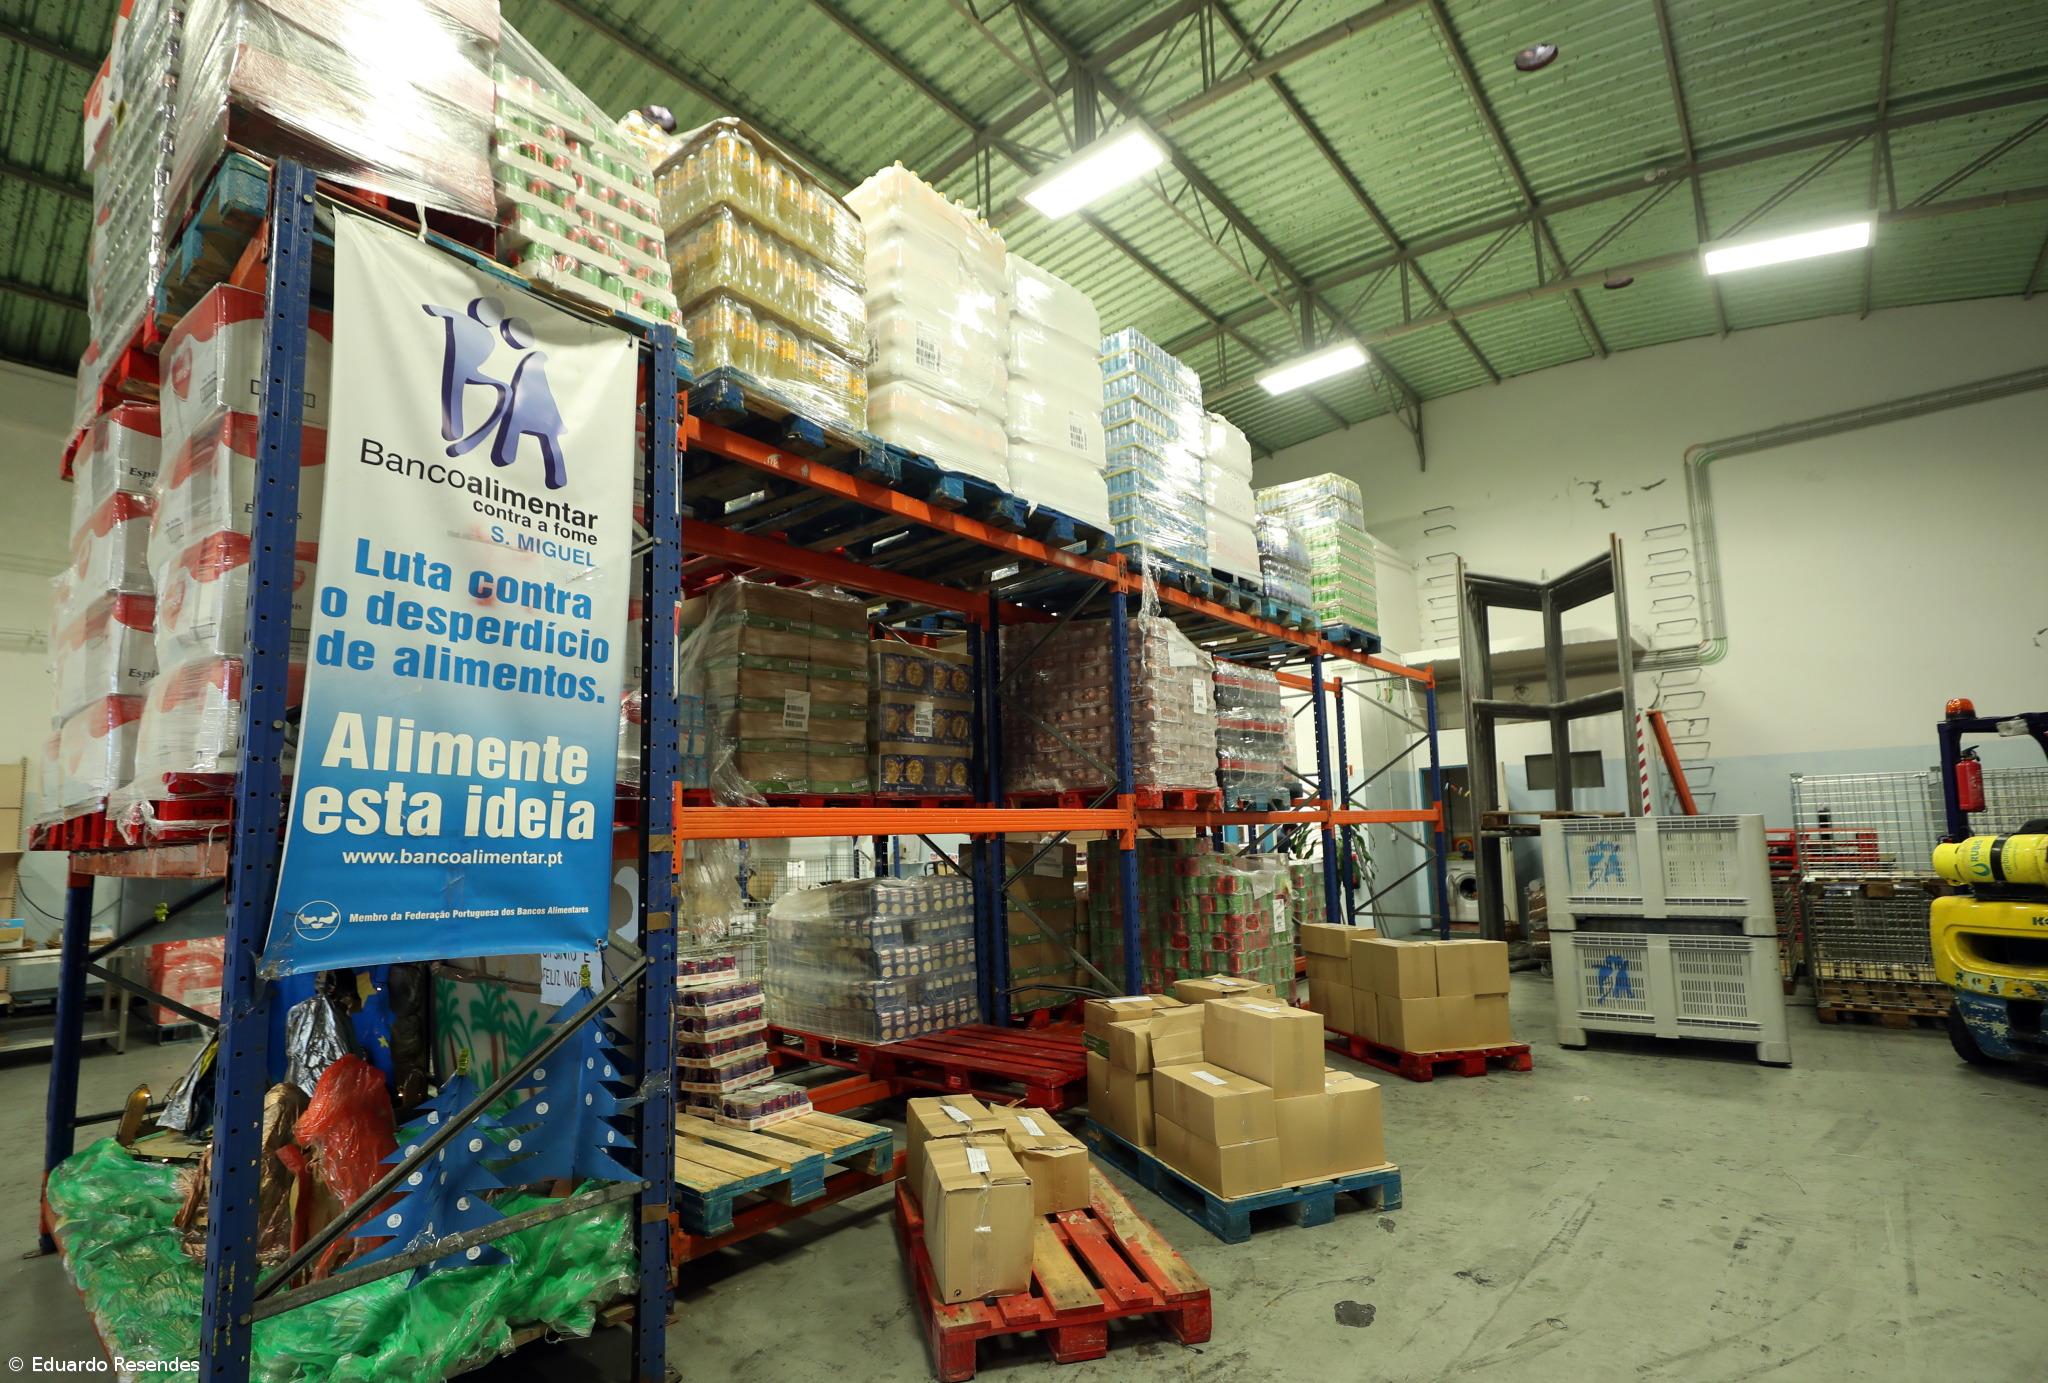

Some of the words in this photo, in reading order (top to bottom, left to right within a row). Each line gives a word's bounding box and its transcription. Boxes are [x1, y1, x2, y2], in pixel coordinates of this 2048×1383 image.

[360, 438, 599, 529] Bancoalimentar
[473, 500, 531, 528] contra
[538, 520, 548, 533] a
[554, 522, 598, 546] fome
[490, 525, 511, 546] S.
[518, 533, 595, 568] MIGUEL
[355, 538, 452, 593] Luta
[468, 570, 592, 620] contra
[320, 586, 348, 618] o
[366, 591, 610, 664] desperdício
[315, 629, 375, 671] de
[393, 644, 605, 704] alimentos.
[321, 711, 589, 785] Alimente
[302, 781, 442, 836] esta
[464, 784, 595, 840] ideia
[342, 848, 563, 867] www.bancoalimentar.pt
[349, 912, 388, 923] Membro
[390, 911, 402, 921] da
[404, 909, 450, 922] Federação
[452, 908, 499, 919] Portuguesa
[501, 907, 515, 916] dos
[517, 906, 545, 915] Bancos
[547, 905, 589, 914] Alimentares
